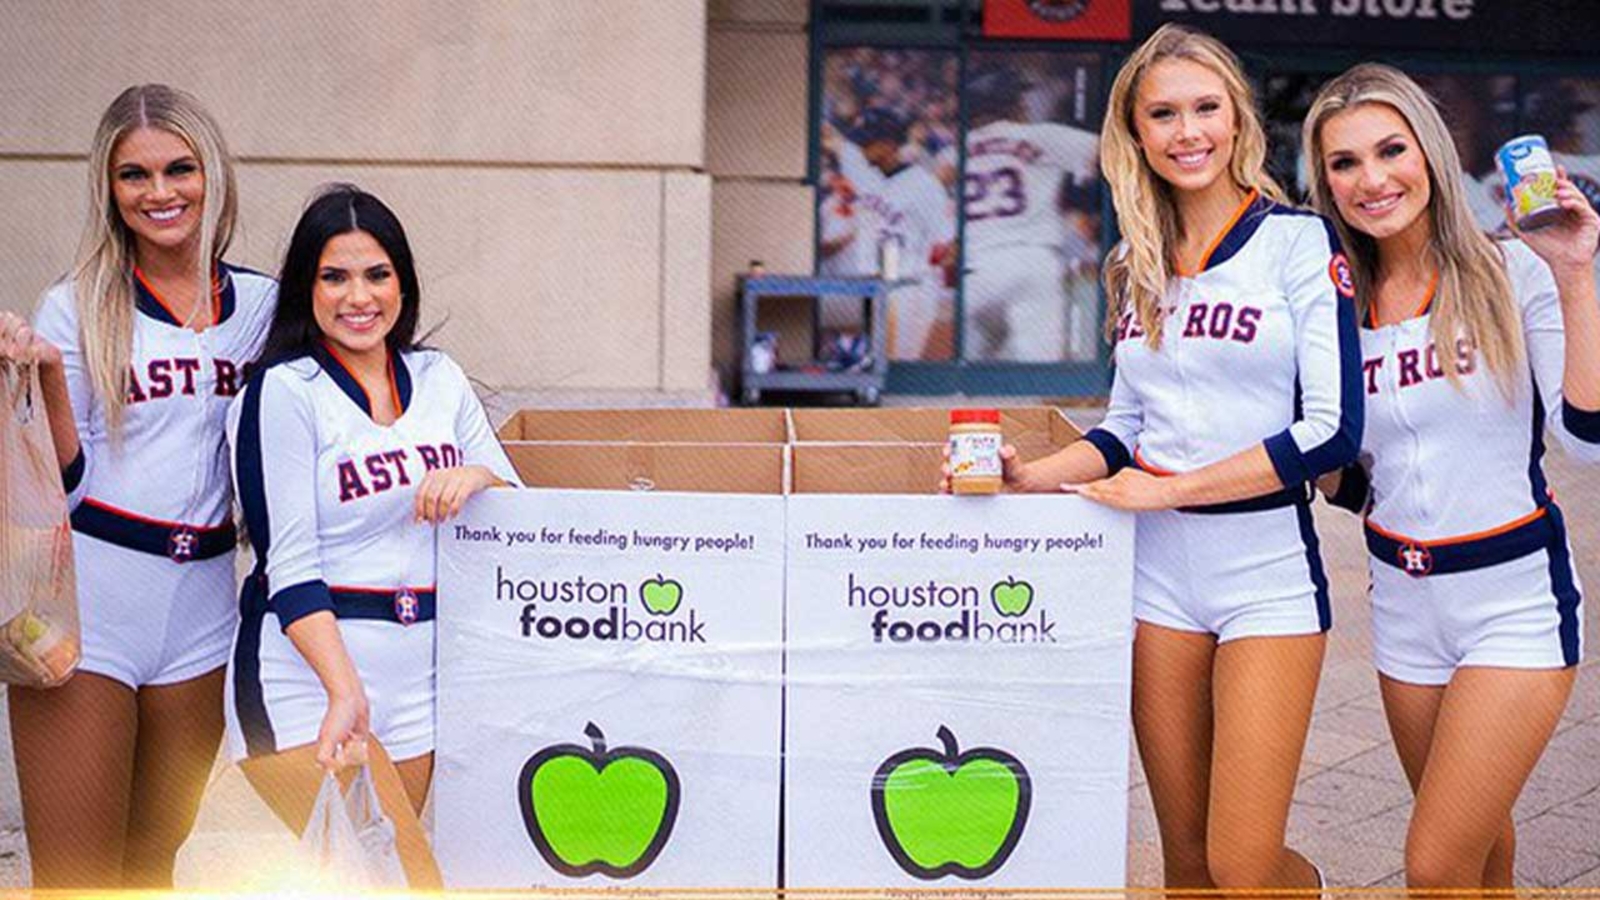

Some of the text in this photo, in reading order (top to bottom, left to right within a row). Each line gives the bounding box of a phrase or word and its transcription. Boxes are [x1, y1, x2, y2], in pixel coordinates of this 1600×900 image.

[454, 524, 755, 552] Thank you for feeding hungry people!
[805, 533, 1103, 553] Thank you for feeding hungry people!
[496, 566, 627, 604] houston
[848, 573, 979, 608] houston
[519, 604, 707, 643] foodbank
[871, 609, 1057, 643] foodbank
